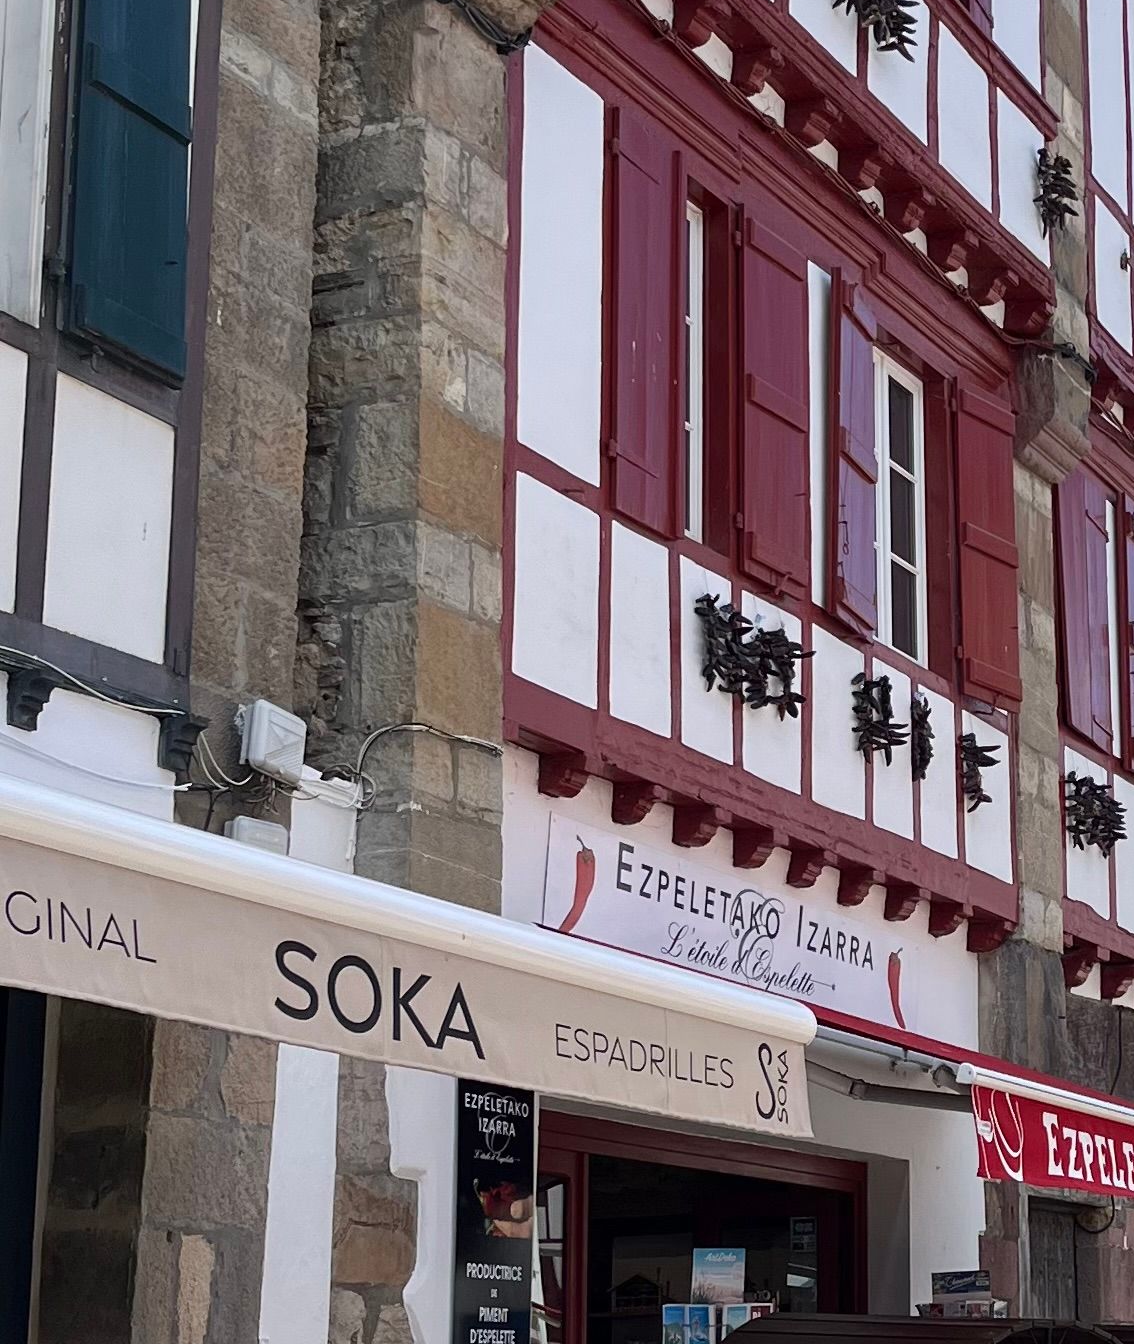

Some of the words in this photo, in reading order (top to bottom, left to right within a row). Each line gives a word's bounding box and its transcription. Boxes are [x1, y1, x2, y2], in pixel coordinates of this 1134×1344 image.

[615, 841, 782, 939] EZPELETAKO
[795, 905, 874, 971] IZARRA
[5, 890, 157, 963] GINAL
[275, 940, 486, 1060] SOKA
[555, 1023, 735, 1089] ESPADRILLES
[777, 1049, 789, 1125] SOKA
[464, 1092, 529, 1118] EZPELETAKO
[478, 1117, 516, 1137] IZARRA
[466, 1262, 523, 1282] PRODUCTRICE
[490, 1288, 498, 1298] DE
[479, 1306, 509, 1323] PIMENT
[469, 1328, 516, 1344] D'ESPELETTE
